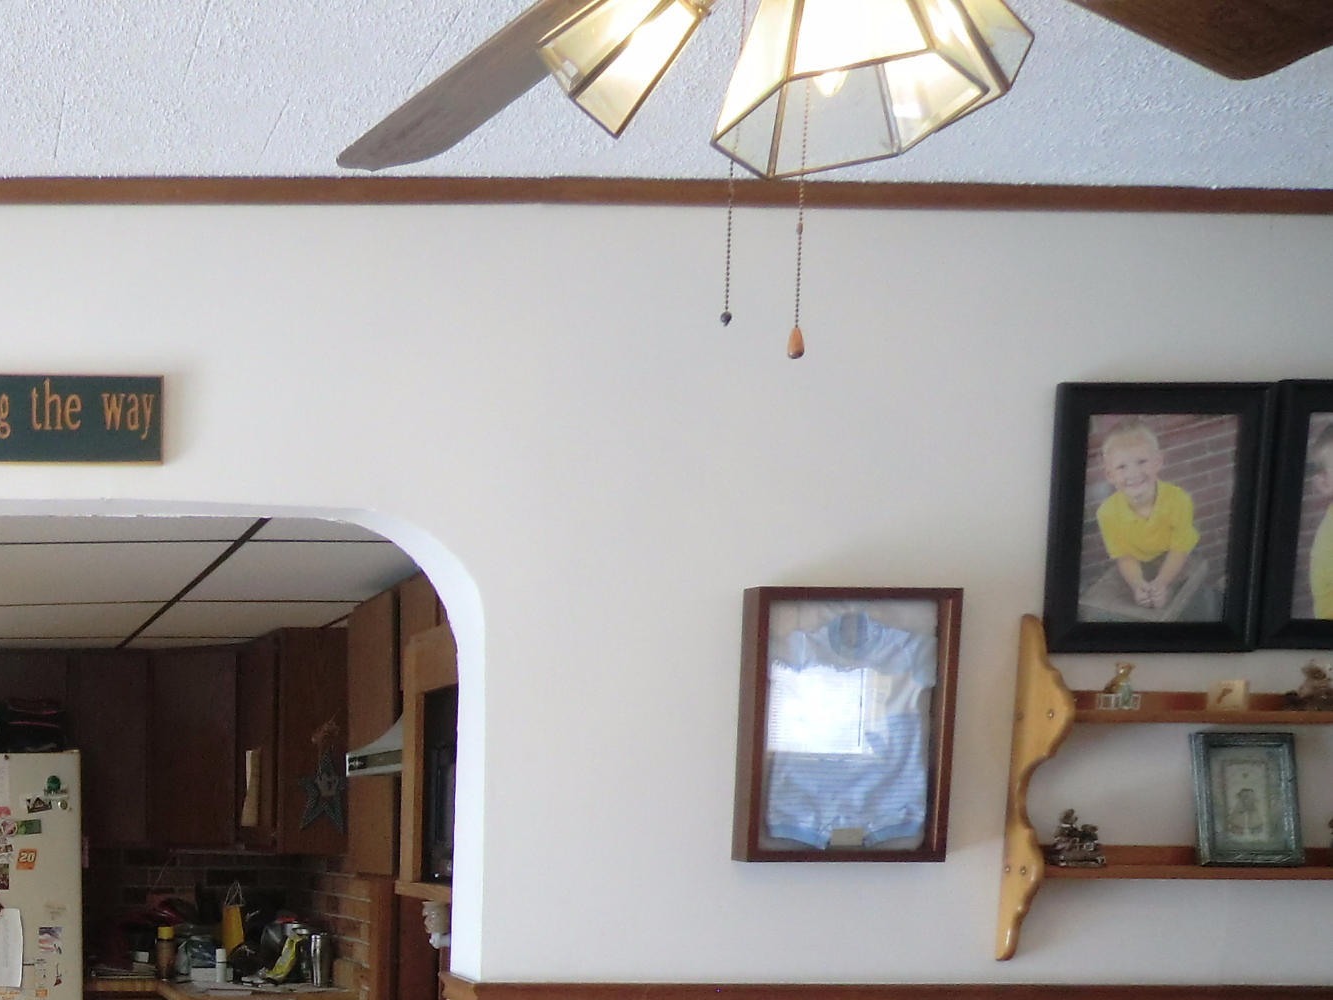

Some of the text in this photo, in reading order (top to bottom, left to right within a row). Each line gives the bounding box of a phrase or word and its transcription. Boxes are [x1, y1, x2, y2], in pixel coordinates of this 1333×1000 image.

[30, 378, 83, 431] the
[100, 391, 155, 440] way
[18, 851, 36, 863] 20
